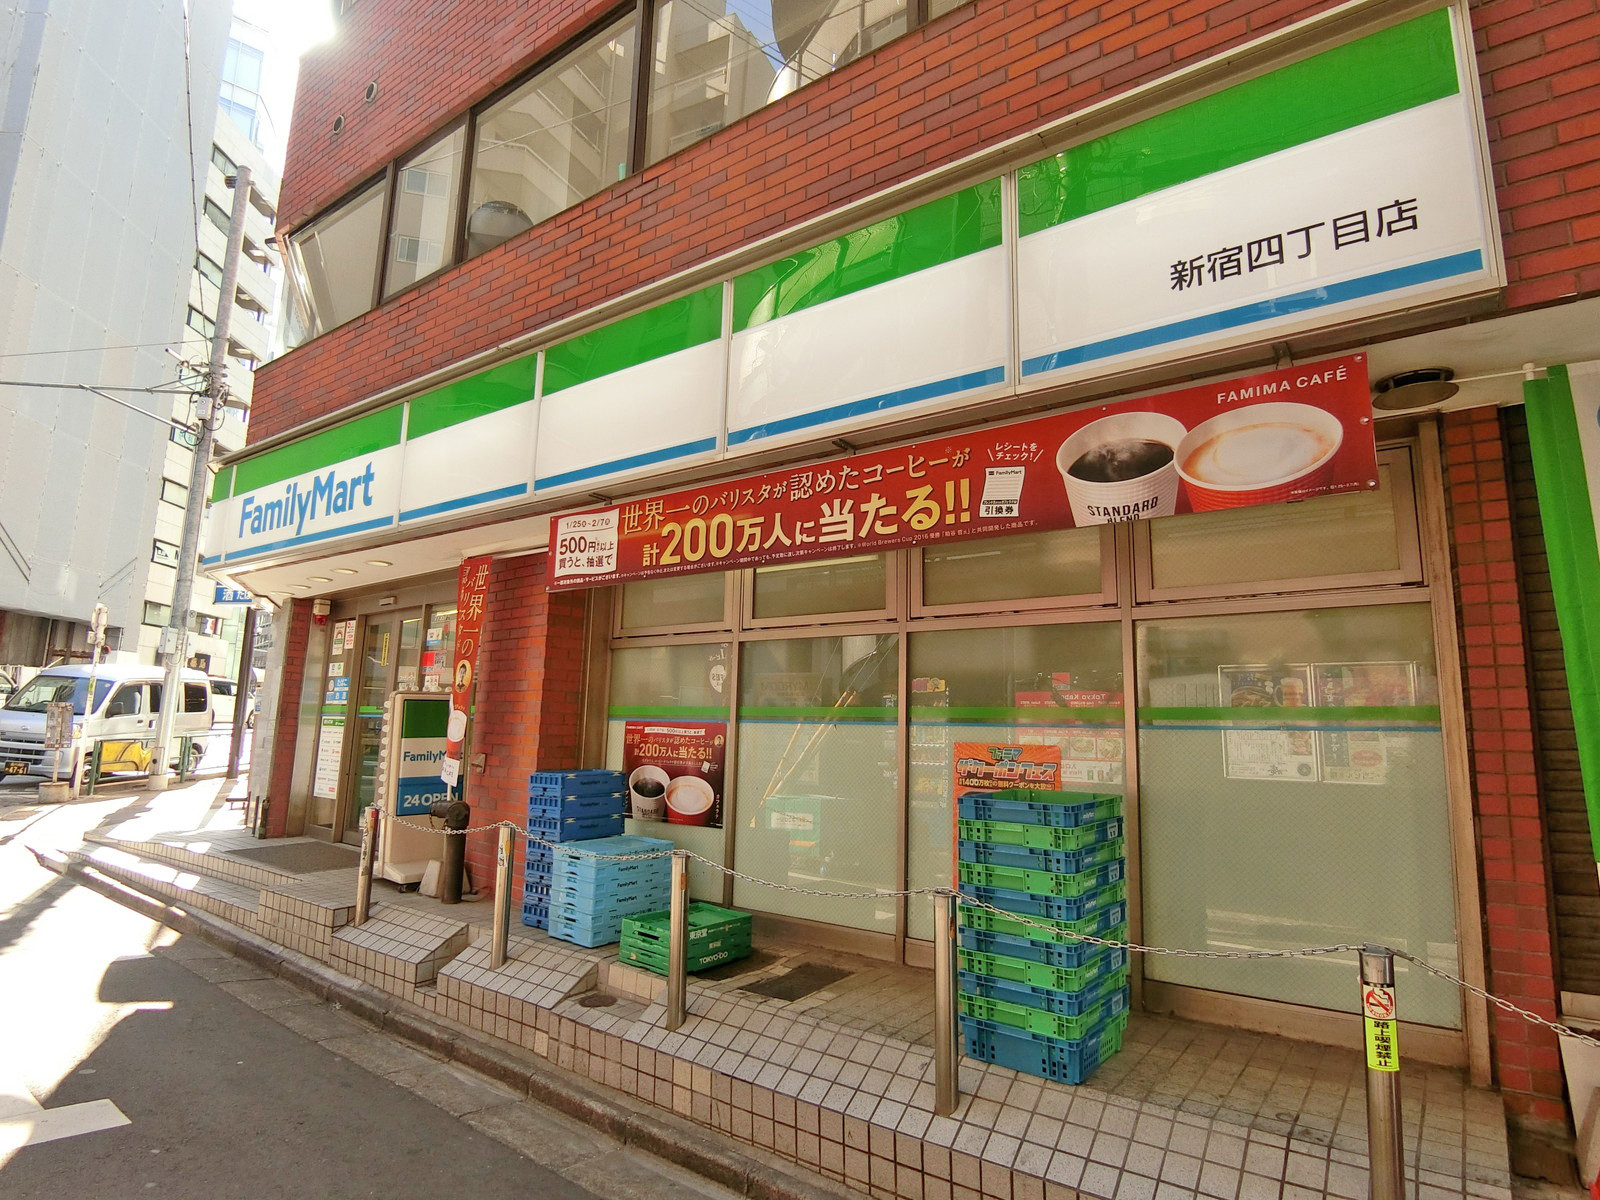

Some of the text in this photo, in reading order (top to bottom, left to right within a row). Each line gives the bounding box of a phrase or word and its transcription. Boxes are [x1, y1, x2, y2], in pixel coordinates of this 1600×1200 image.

[1169, 197, 1419, 292] 新宿四丁目店
[1216, 365, 1349, 404] FAMIMA CAFÉ
[995, 442, 1038, 452] レシートを
[239, 461, 375, 538] FamilyMart
[985, 505, 1014, 515] 引換券
[1087, 496, 1159, 517] STANDARD
[913, 533, 929, 541] 2016
[988, 747, 1023, 760] ファミマ
[1373, 1020, 1393, 1067] 路上喫煙禁止
